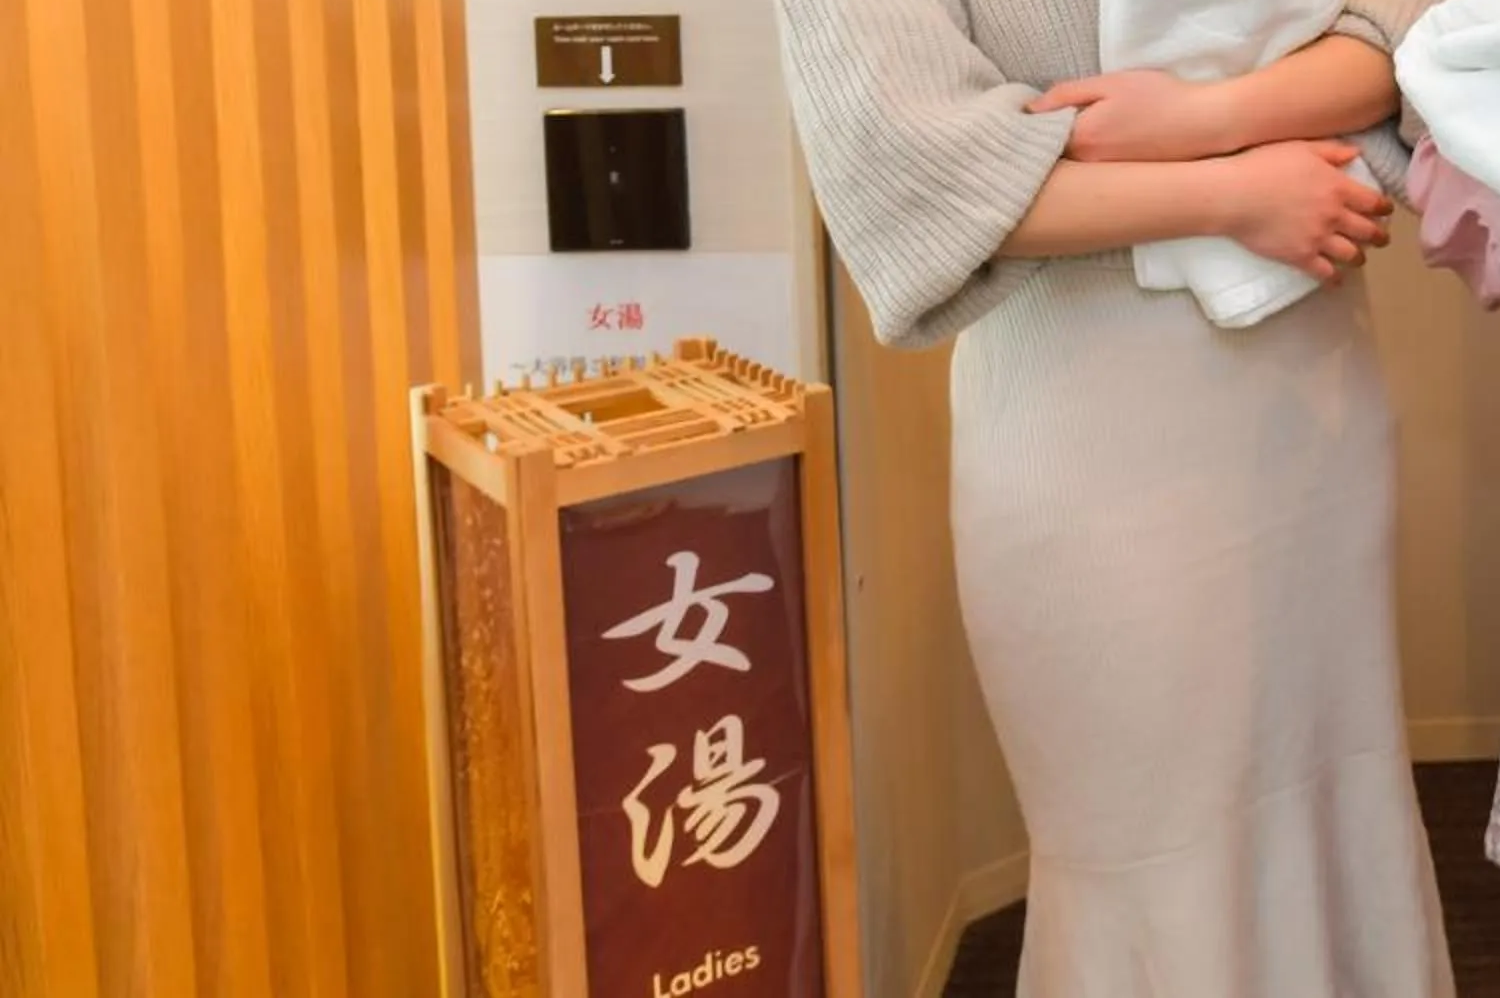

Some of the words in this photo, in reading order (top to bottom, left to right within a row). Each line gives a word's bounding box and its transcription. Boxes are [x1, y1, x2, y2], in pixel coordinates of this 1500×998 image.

[587, 303, 644, 330] 女湯
[602, 551, 781, 888] 女湯
[653, 946, 760, 998] Ladies
